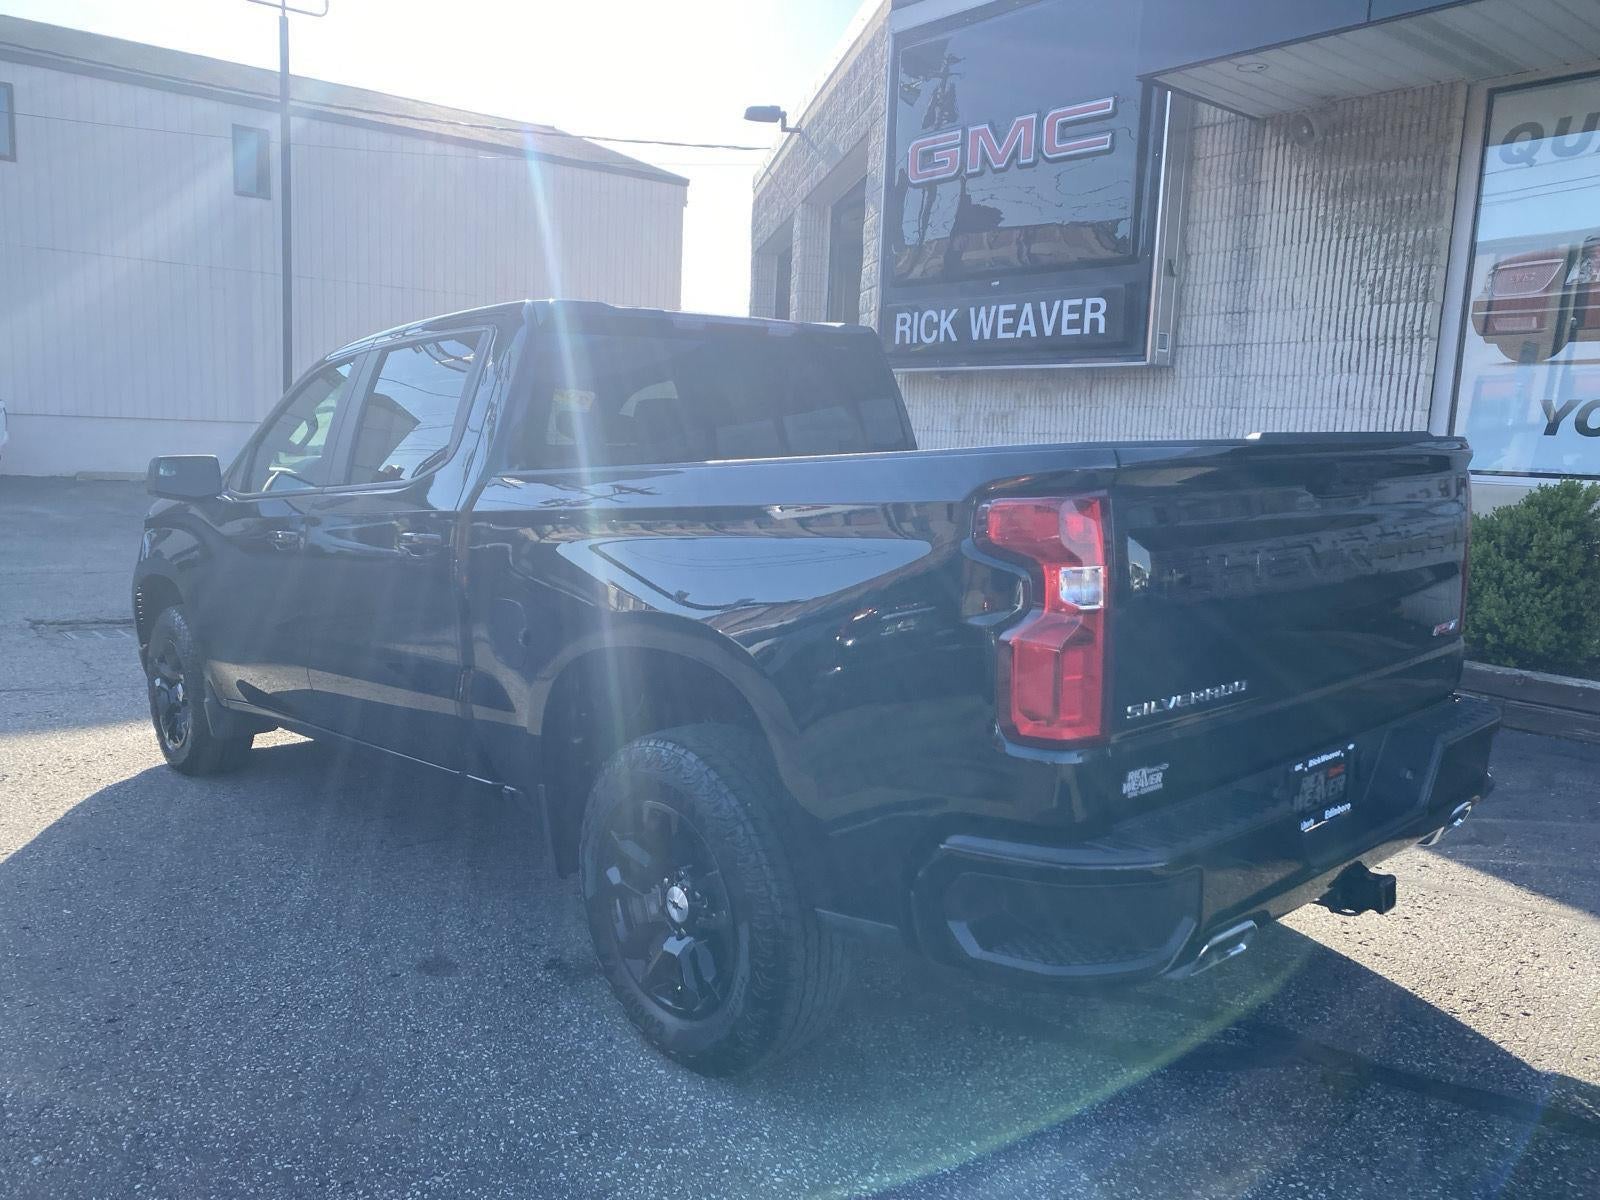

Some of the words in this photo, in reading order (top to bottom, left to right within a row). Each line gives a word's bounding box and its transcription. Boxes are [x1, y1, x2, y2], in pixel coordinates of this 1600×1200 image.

[908, 97, 1115, 184] GMC
[1499, 112, 1600, 167] QU
[895, 308, 958, 345] RICK
[969, 297, 1107, 341] WEAVER
[1126, 679, 1247, 719] SILVERADO
